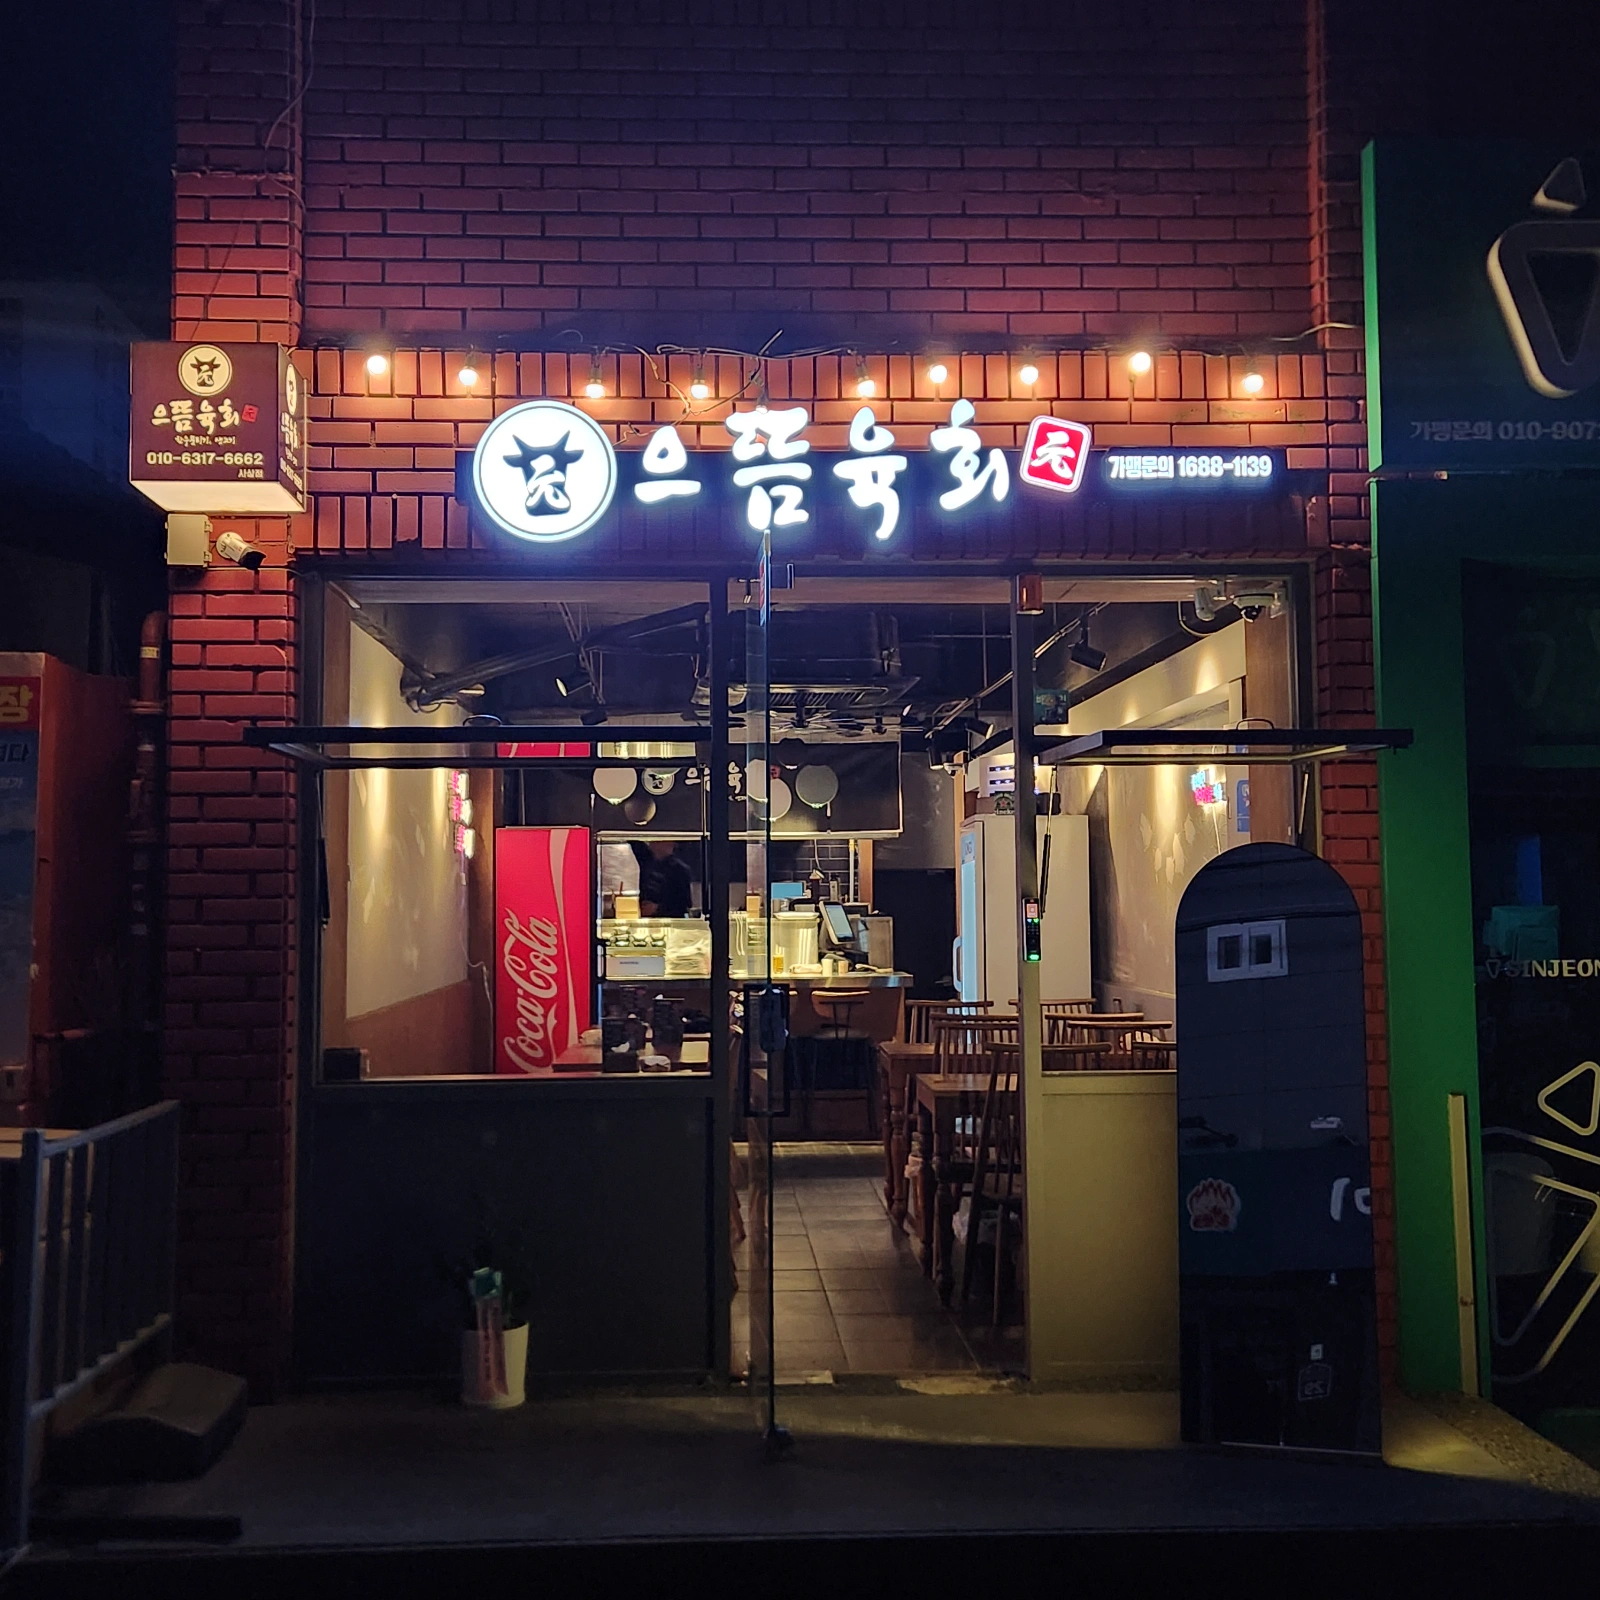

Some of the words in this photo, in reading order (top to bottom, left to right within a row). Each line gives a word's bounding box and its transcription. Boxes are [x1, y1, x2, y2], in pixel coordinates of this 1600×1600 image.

[1409, 420, 1493, 441] 가맹문의
[1499, 420, 1600, 440] 010-907
[146, 452, 264, 465] 010-6317-6662
[1108, 455, 1175, 479] 가맹문의
[1177, 455, 1273, 478] 1688-1139
[504, 907, 558, 1074] Coca-Cola
